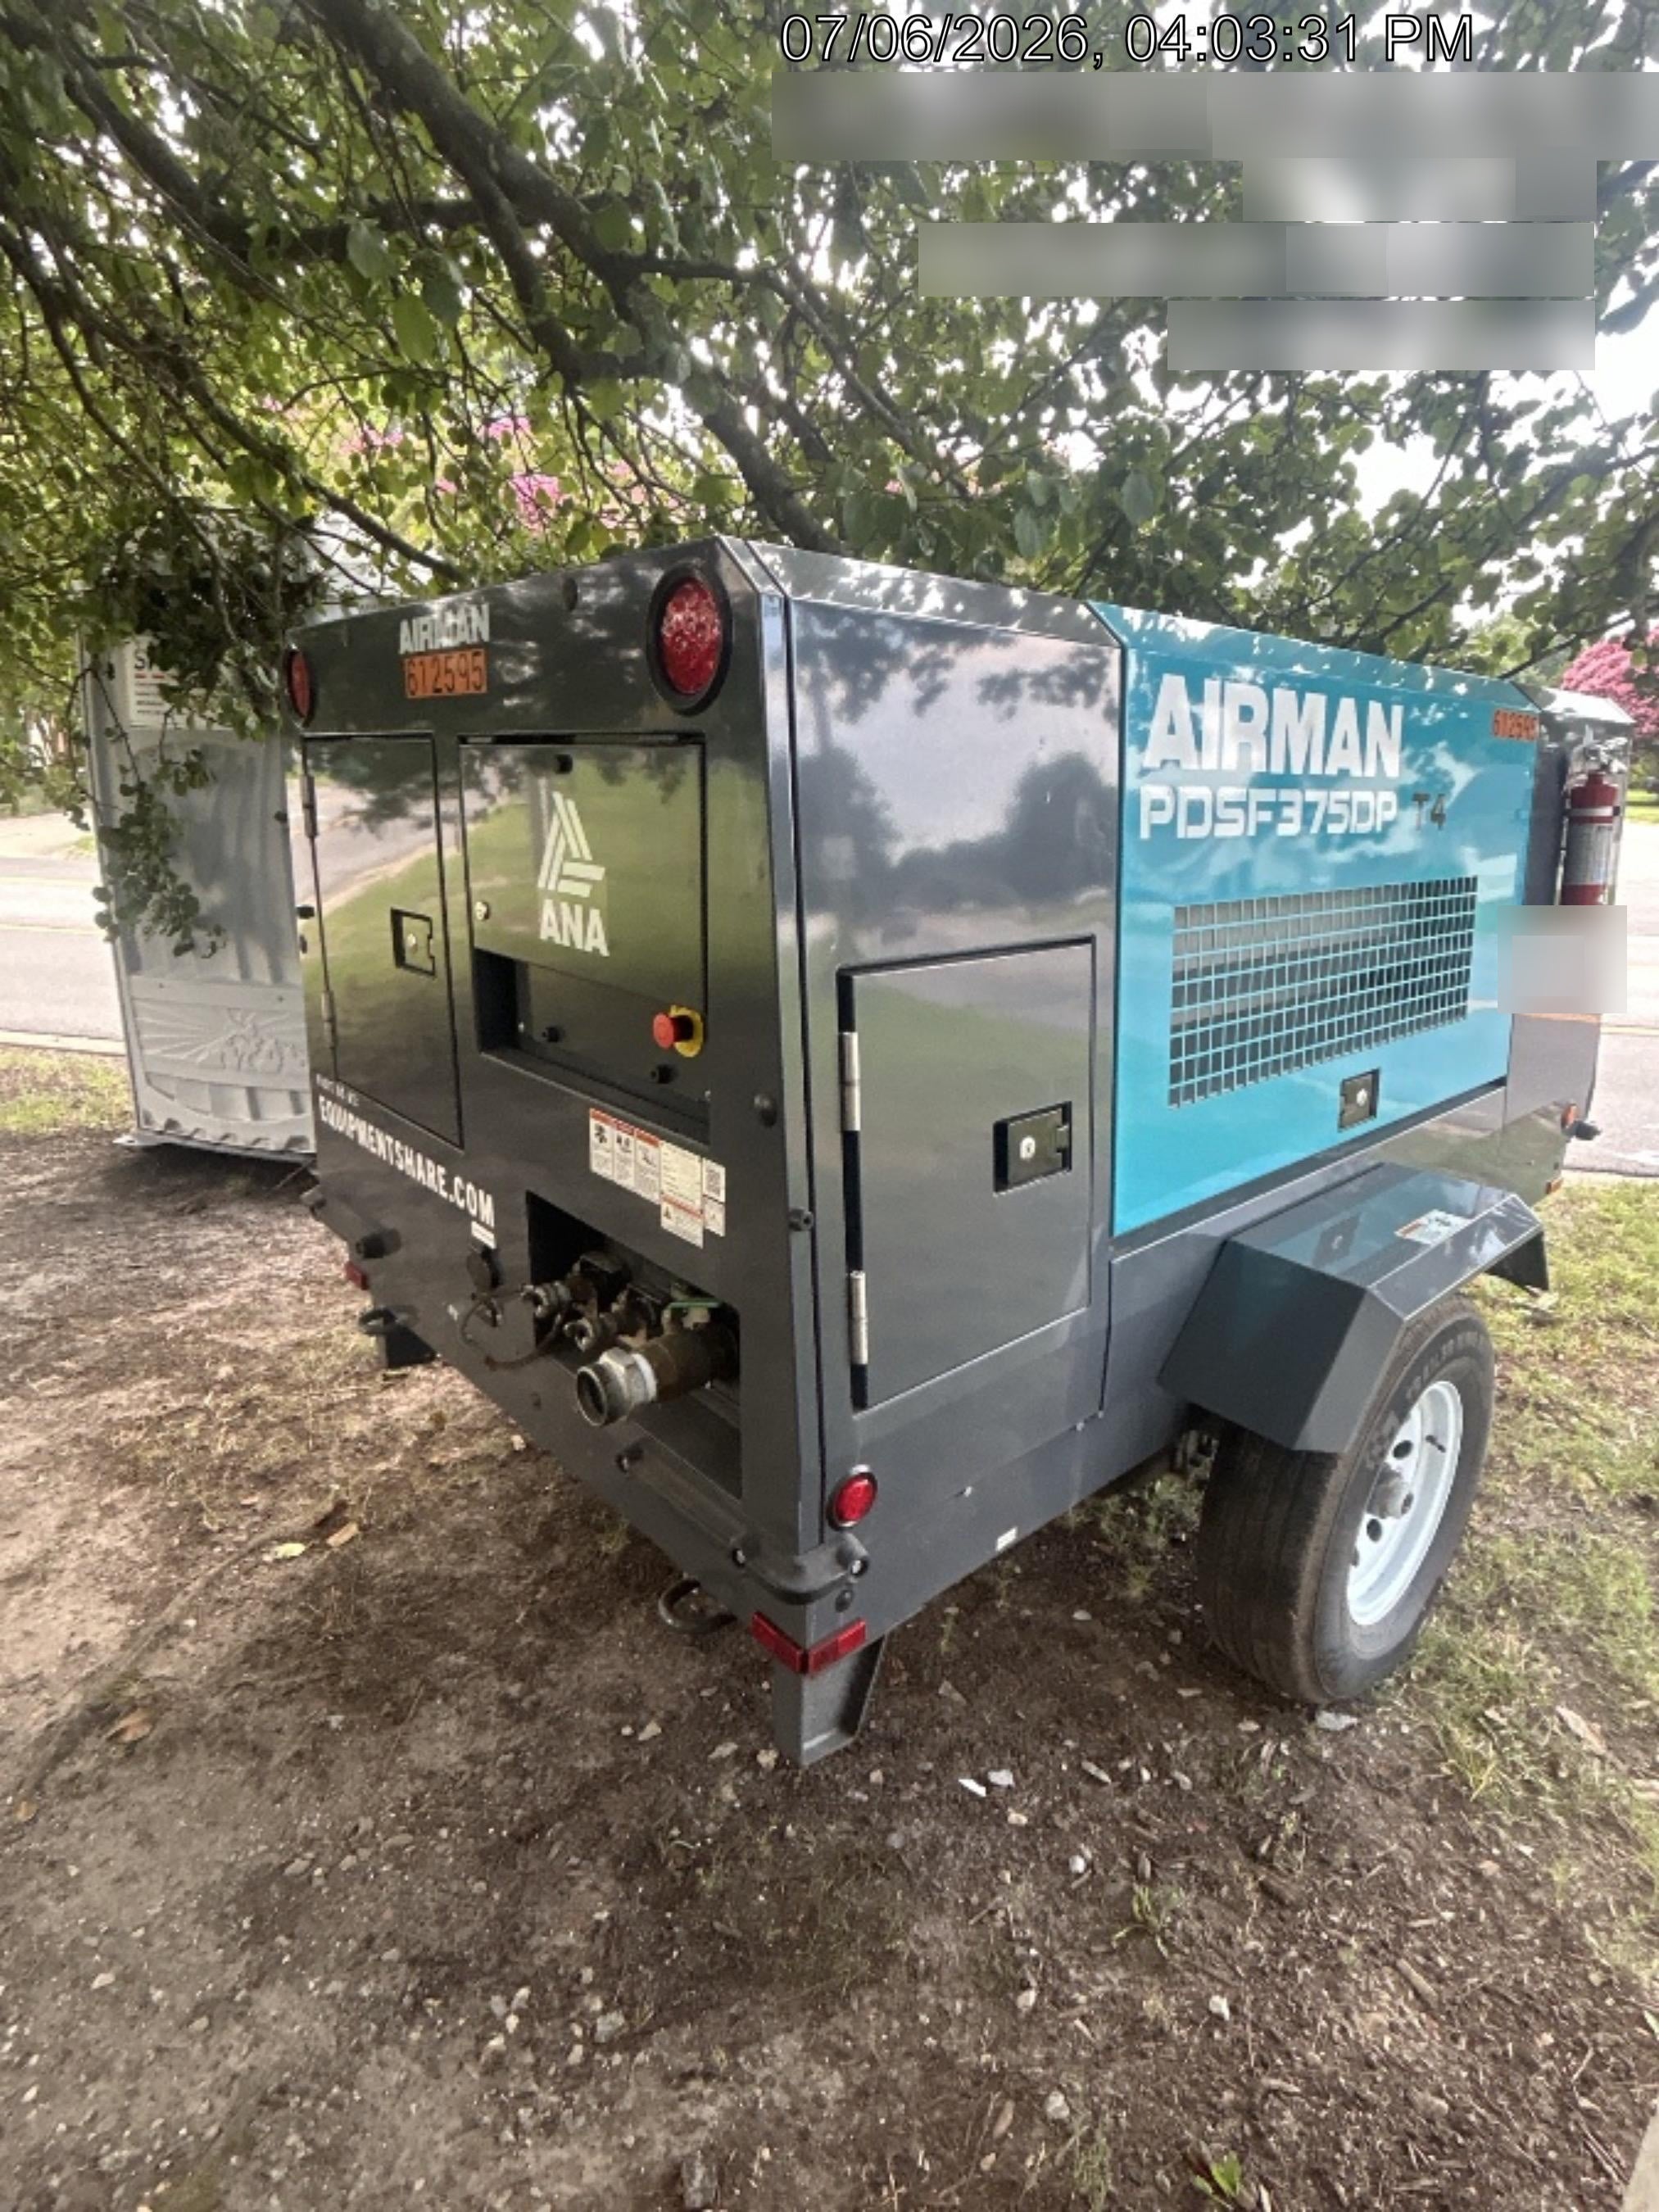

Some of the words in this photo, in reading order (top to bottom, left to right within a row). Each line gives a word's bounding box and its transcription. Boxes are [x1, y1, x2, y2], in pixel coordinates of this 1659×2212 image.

[398, 603, 490, 655] AIRMAN
[407, 650, 483, 696] 612595
[1143, 673, 1404, 777] AIRMAN
[1140, 784, 1398, 841] PDSF375DP
[1412, 792, 1448, 832] T4
[540, 899, 610, 957] ANA
[319, 1094, 496, 1229] EQUIPMENTSHARE.COM
